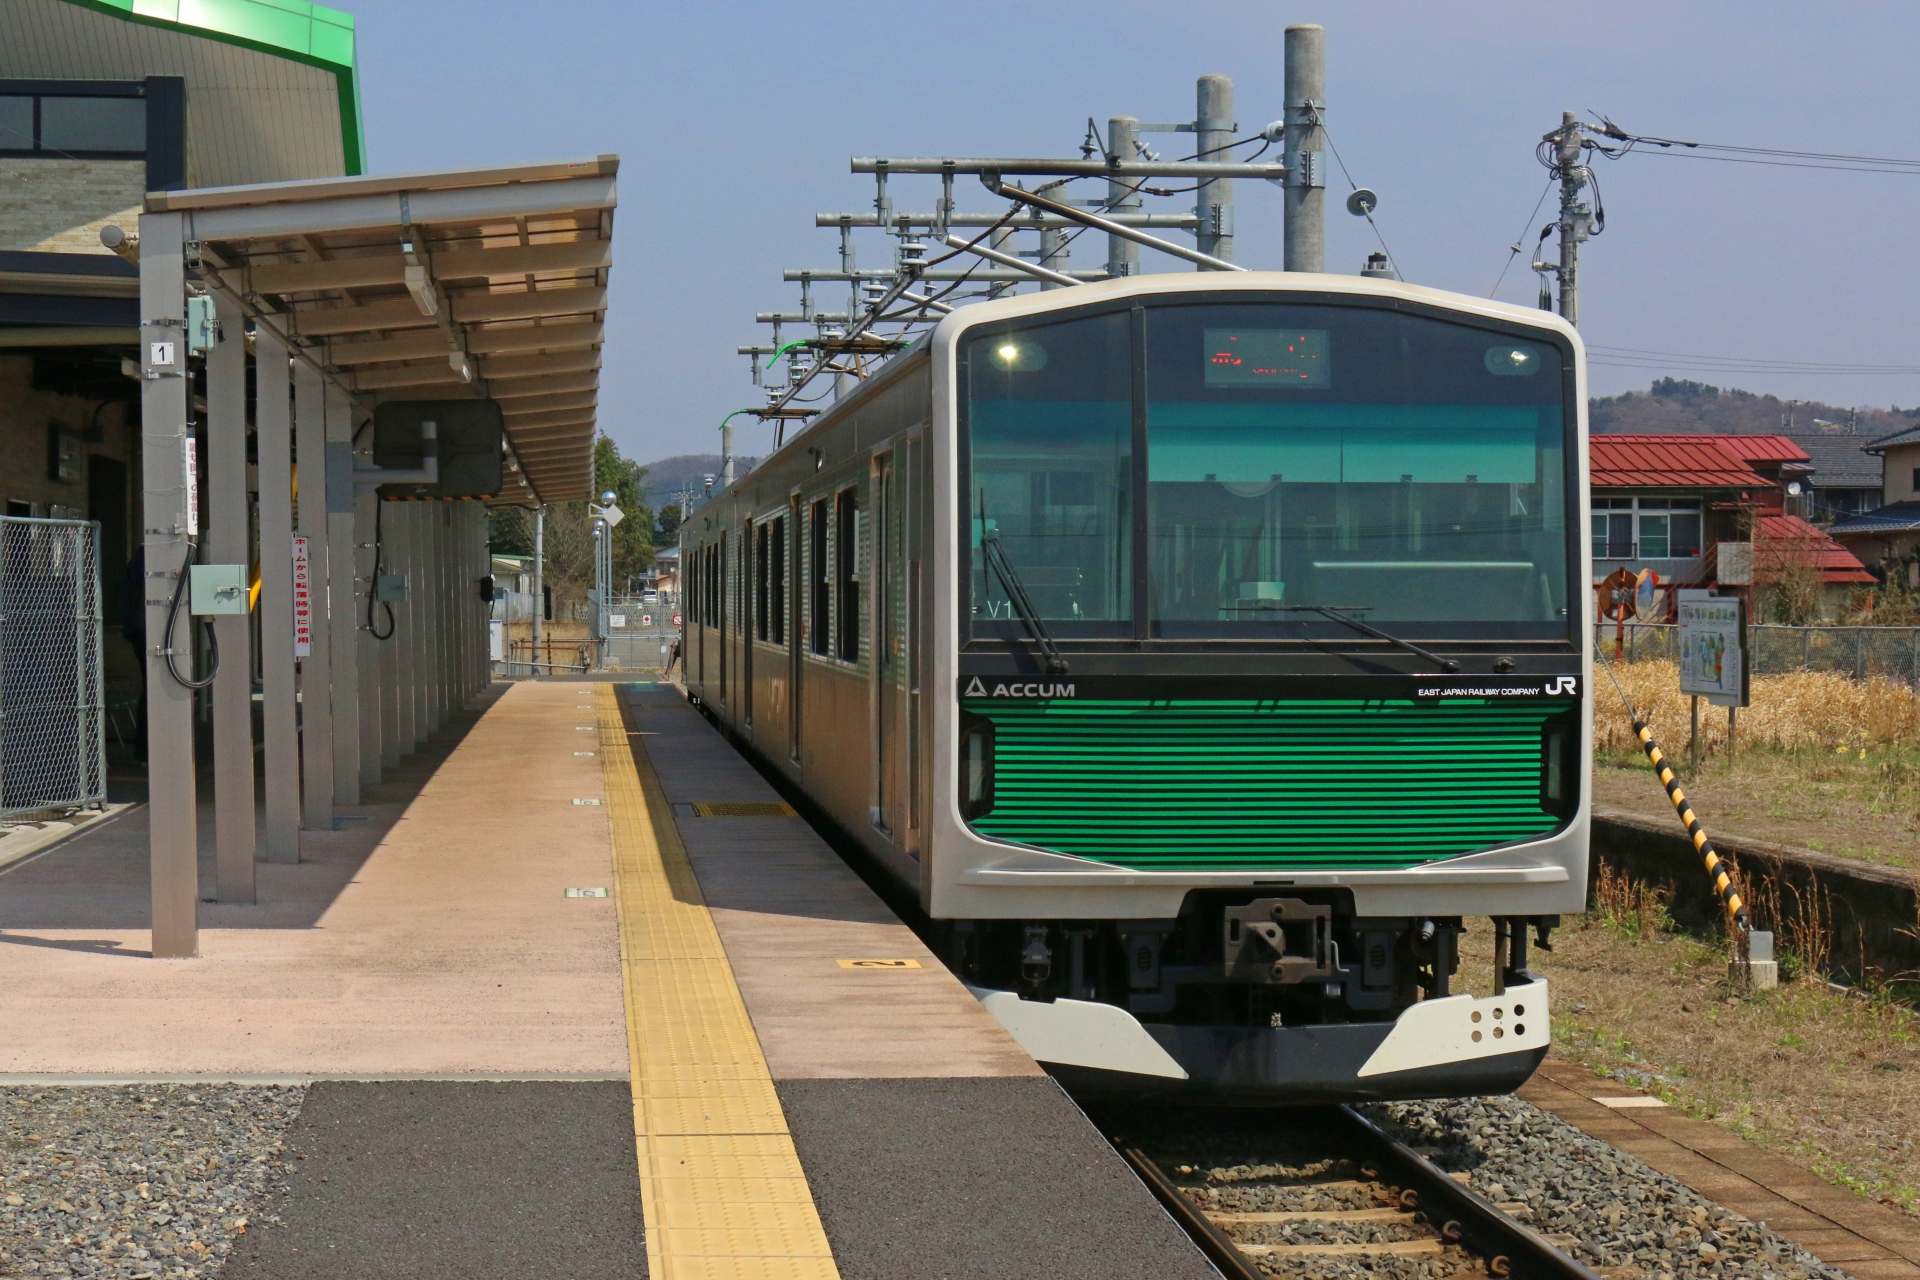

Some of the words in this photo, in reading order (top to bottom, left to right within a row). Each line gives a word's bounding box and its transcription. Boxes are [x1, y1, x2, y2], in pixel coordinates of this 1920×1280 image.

[158, 345, 165, 362] 1
[295, 538, 309, 644] ホームから転落時等に使用
[987, 600, 1011, 619] V1
[992, 683, 1075, 697] ACCUM
[1418, 688, 1441, 697] EAST
[1441, 688, 1468, 696] JAPAN
[1468, 688, 1500, 696] RAILWAY
[1501, 688, 1540, 696] COMPANY
[1545, 676, 1577, 695] JR
